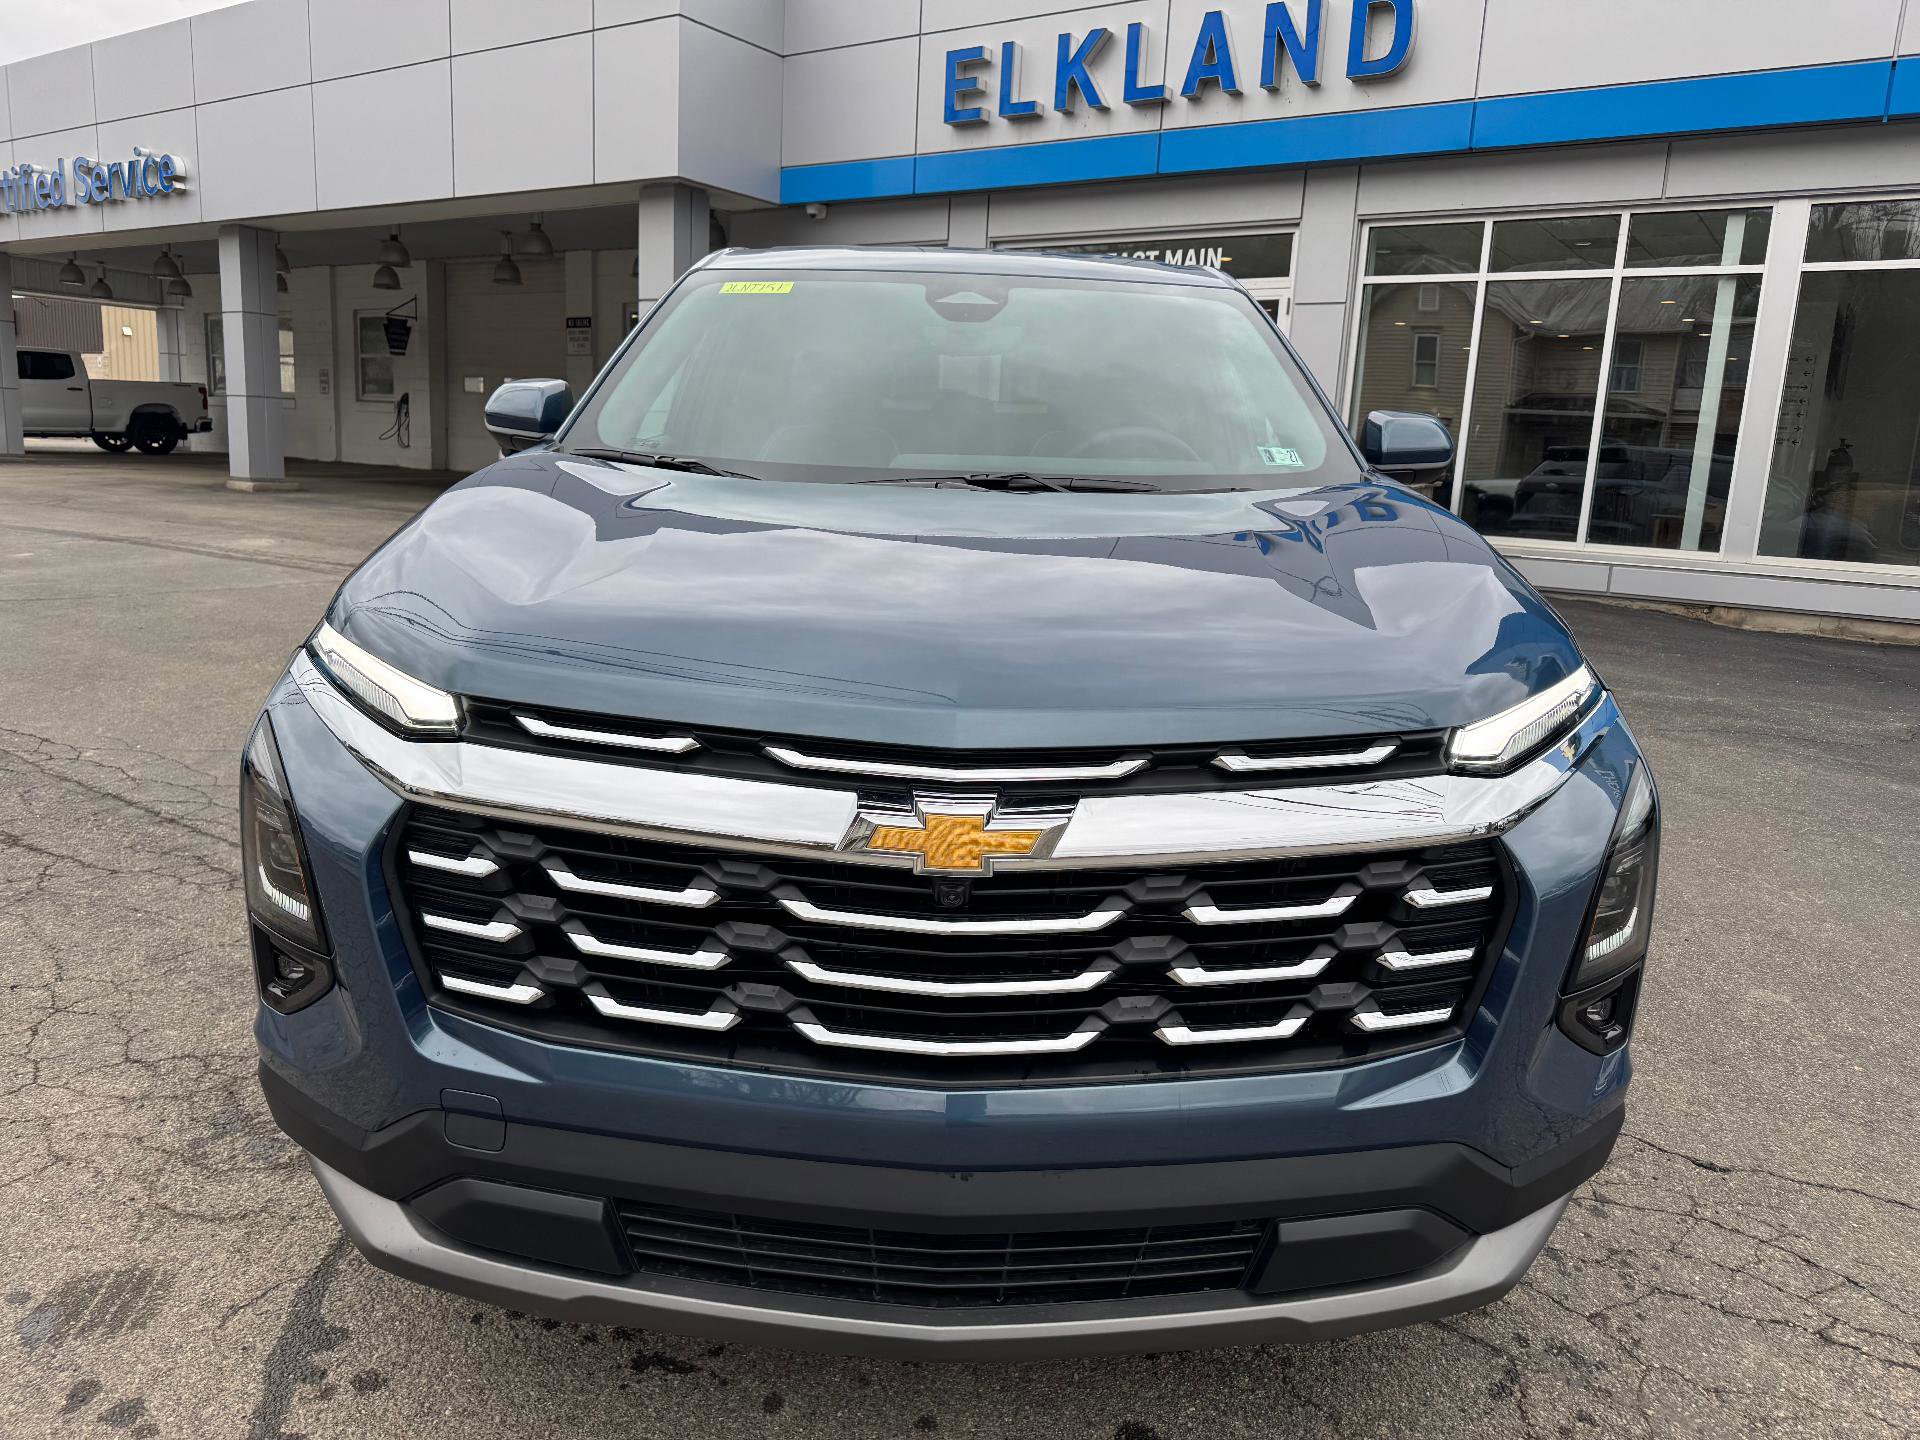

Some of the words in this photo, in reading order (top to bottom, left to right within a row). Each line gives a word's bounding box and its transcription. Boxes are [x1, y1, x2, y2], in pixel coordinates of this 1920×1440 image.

[943, 0, 1417, 126] ELKLAND
[74, 146, 182, 204] Service
[1165, 247, 1223, 269] MAIN
